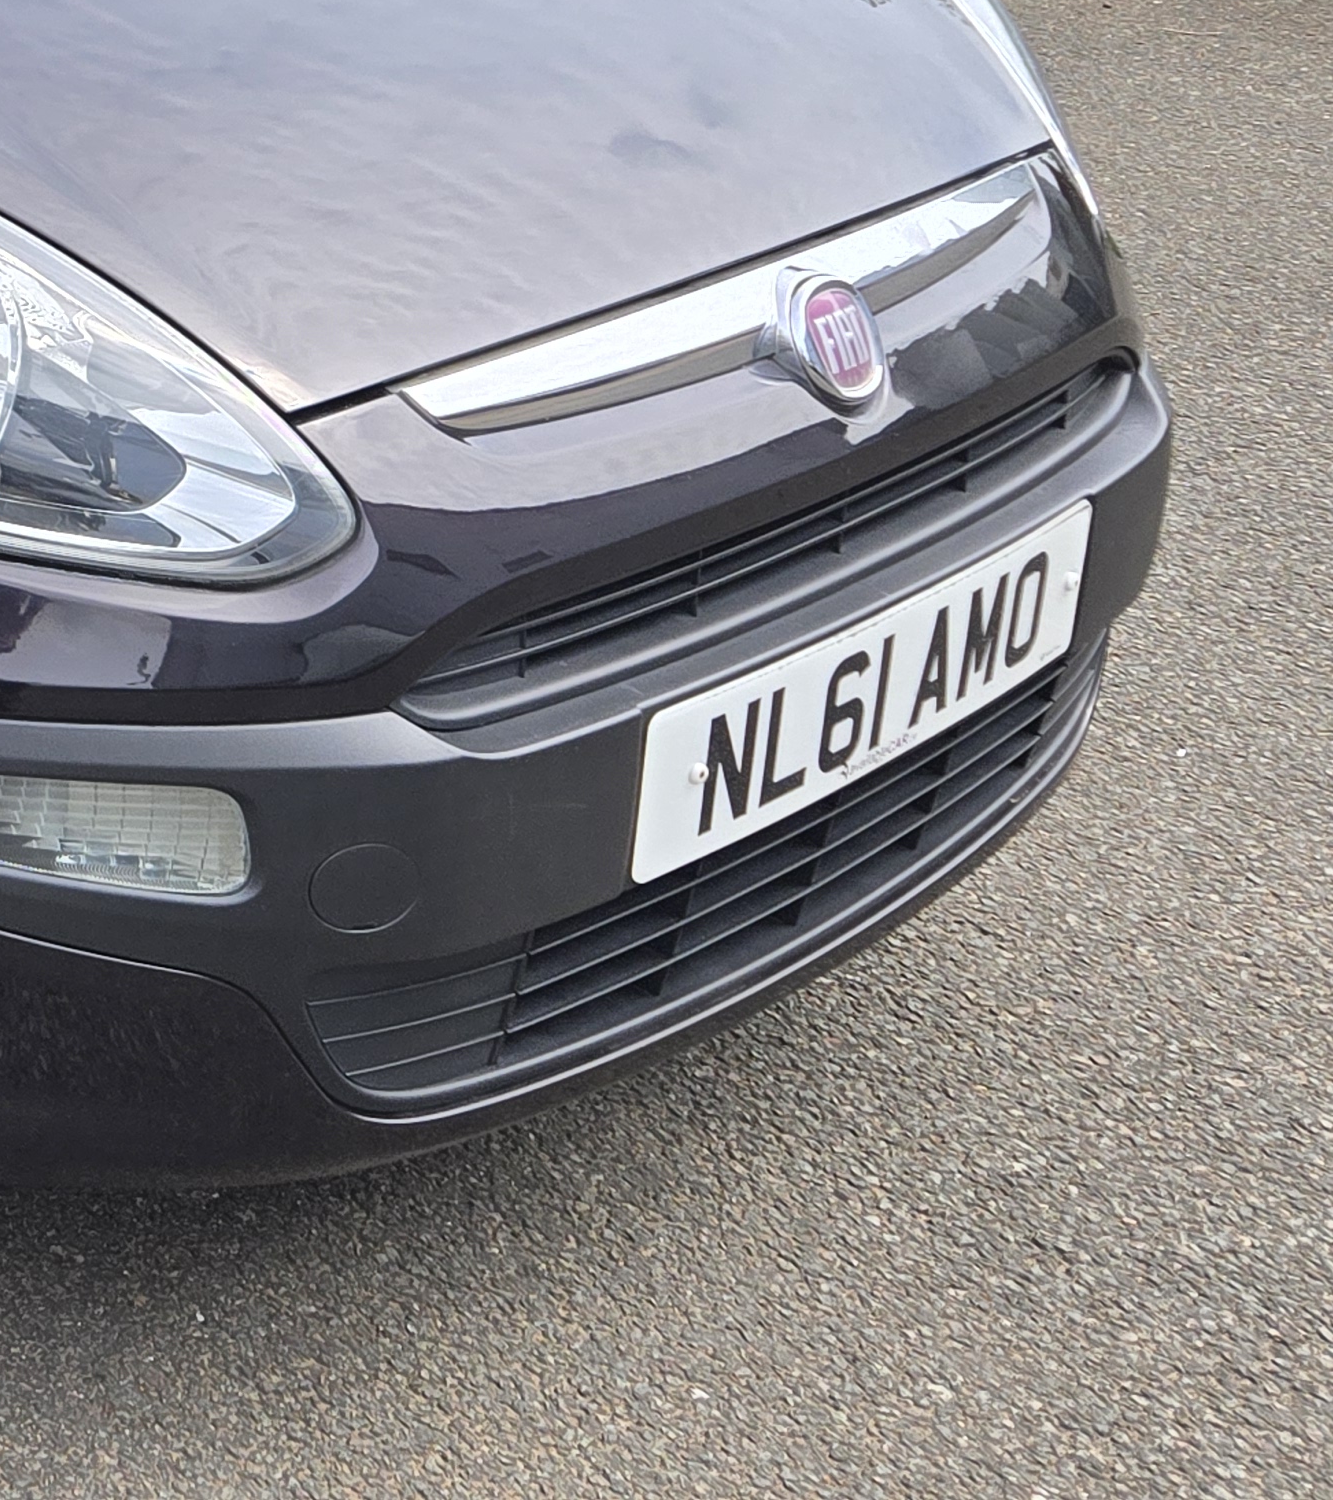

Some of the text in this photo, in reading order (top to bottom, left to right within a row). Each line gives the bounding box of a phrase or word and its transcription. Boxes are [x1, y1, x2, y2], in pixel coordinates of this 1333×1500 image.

[813, 304, 871, 375] FIAT
[697, 550, 1050, 838] NL61 AMO
